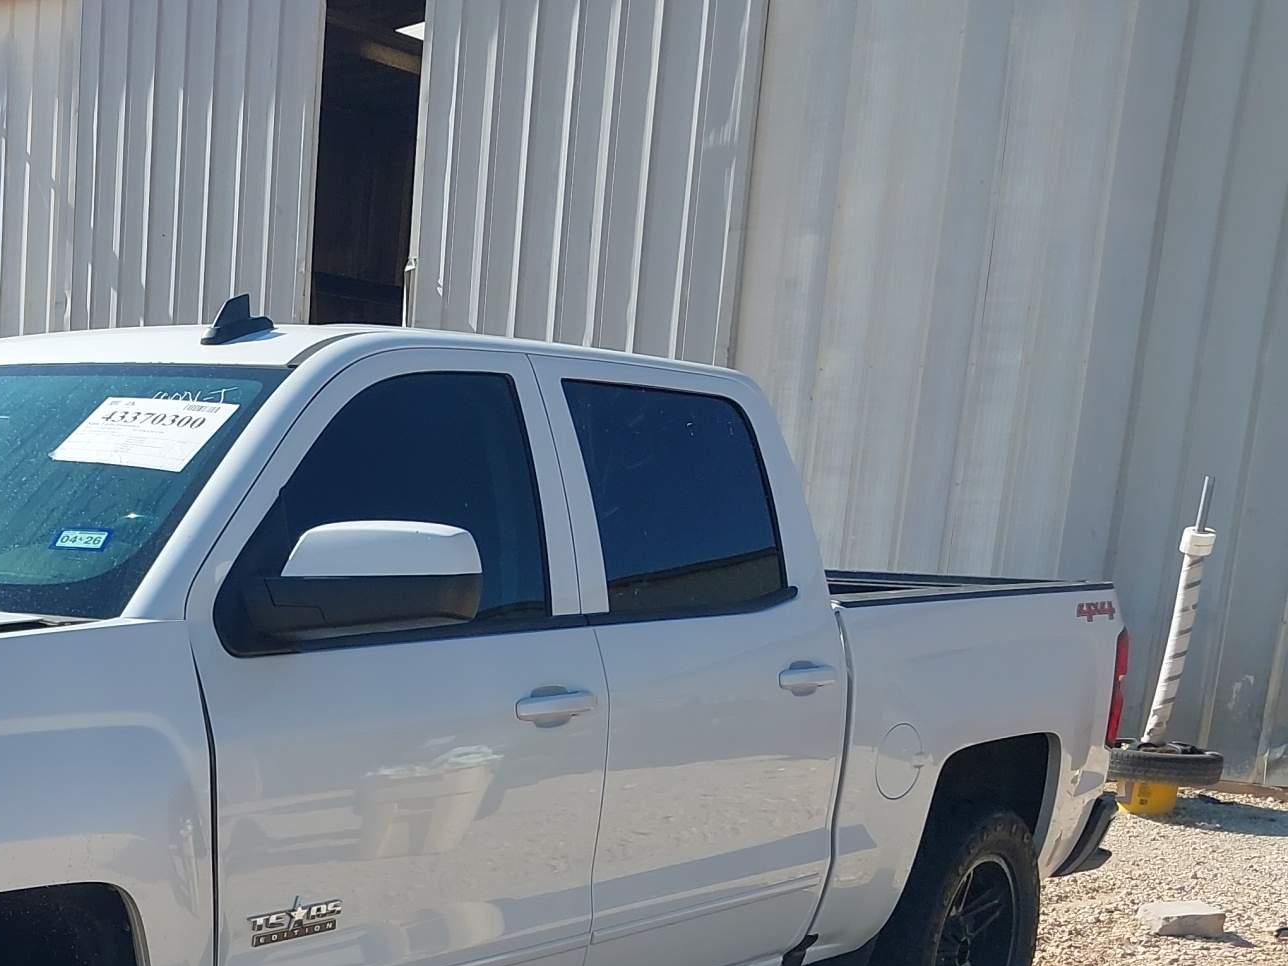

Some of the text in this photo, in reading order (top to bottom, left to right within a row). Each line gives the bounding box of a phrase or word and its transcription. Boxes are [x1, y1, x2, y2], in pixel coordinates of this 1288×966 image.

[101, 409, 207, 430] 43370300
[247, 896, 343, 931] TEXAS
[258, 921, 334, 943] EDITION
